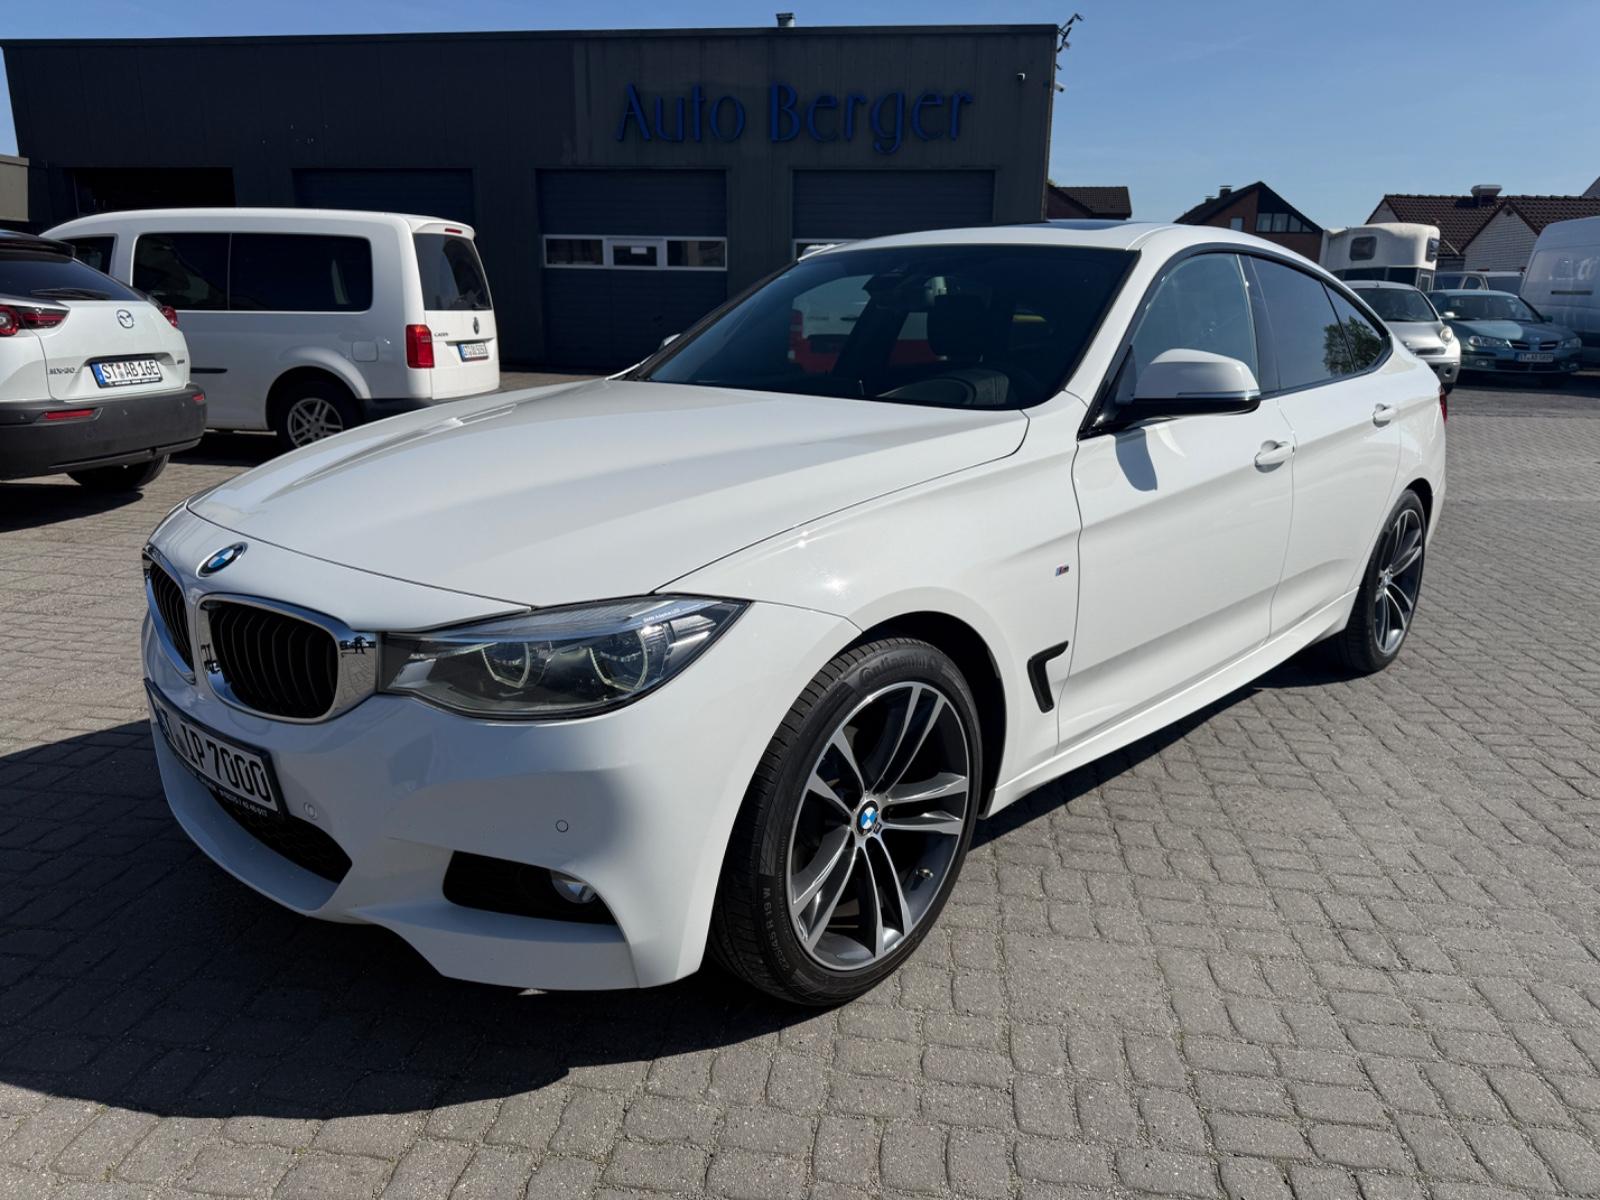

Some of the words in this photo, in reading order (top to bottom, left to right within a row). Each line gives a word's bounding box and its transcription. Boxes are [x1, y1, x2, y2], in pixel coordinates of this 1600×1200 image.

[615, 81, 747, 143] Auto
[768, 80, 974, 155] Berger
[101, 361, 118, 379] ST
[125, 360, 138, 378] AB
[138, 359, 159, 377] 16E
[206, 740, 272, 802] 7000
